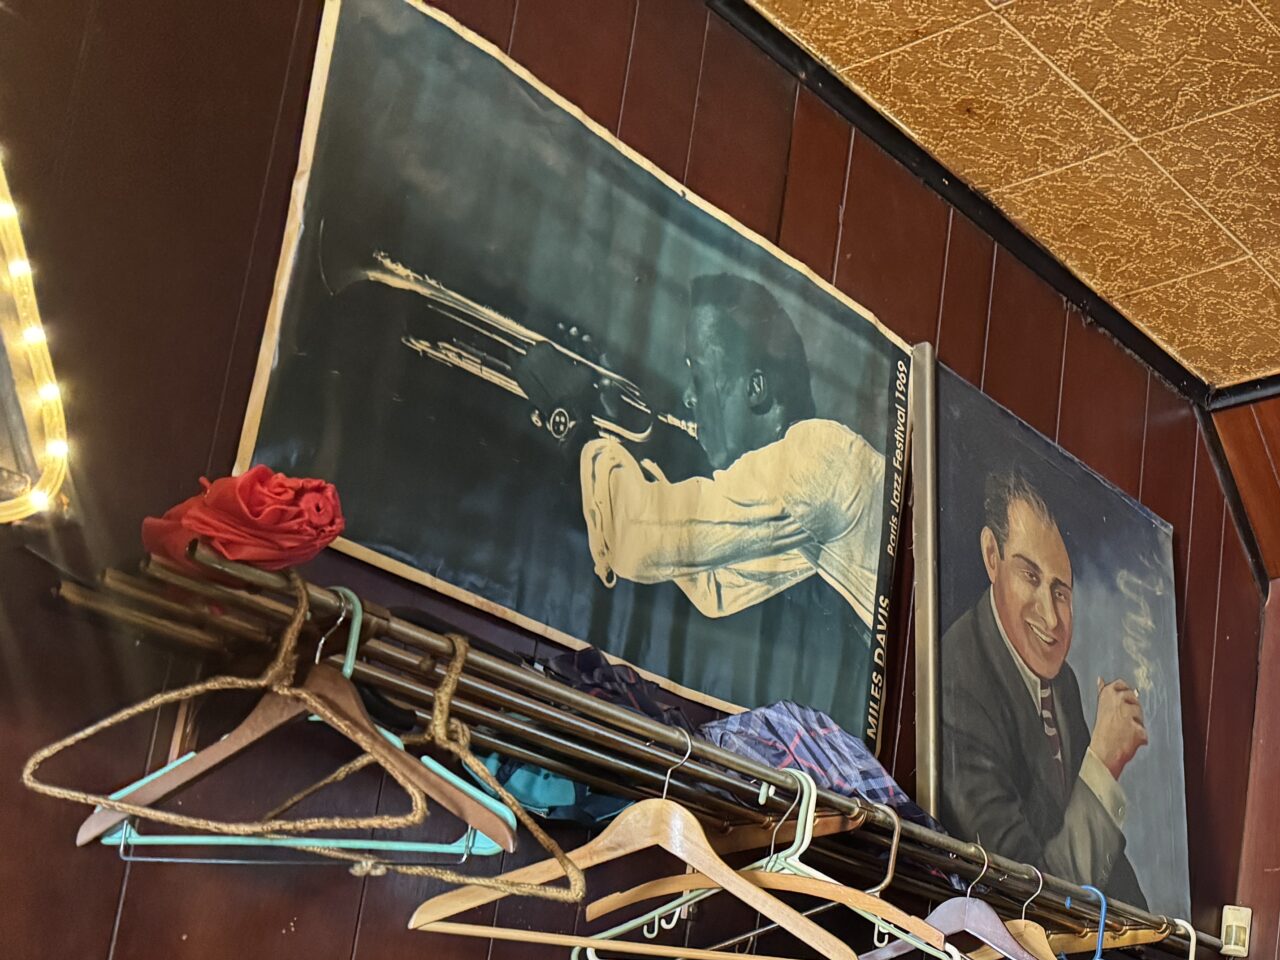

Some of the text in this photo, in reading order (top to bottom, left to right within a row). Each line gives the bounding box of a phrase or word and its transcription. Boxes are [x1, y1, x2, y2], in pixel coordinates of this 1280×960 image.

[887, 360, 907, 557] Paris Jazz Festival 1969
[866, 594, 890, 740] MILES DAVIS
